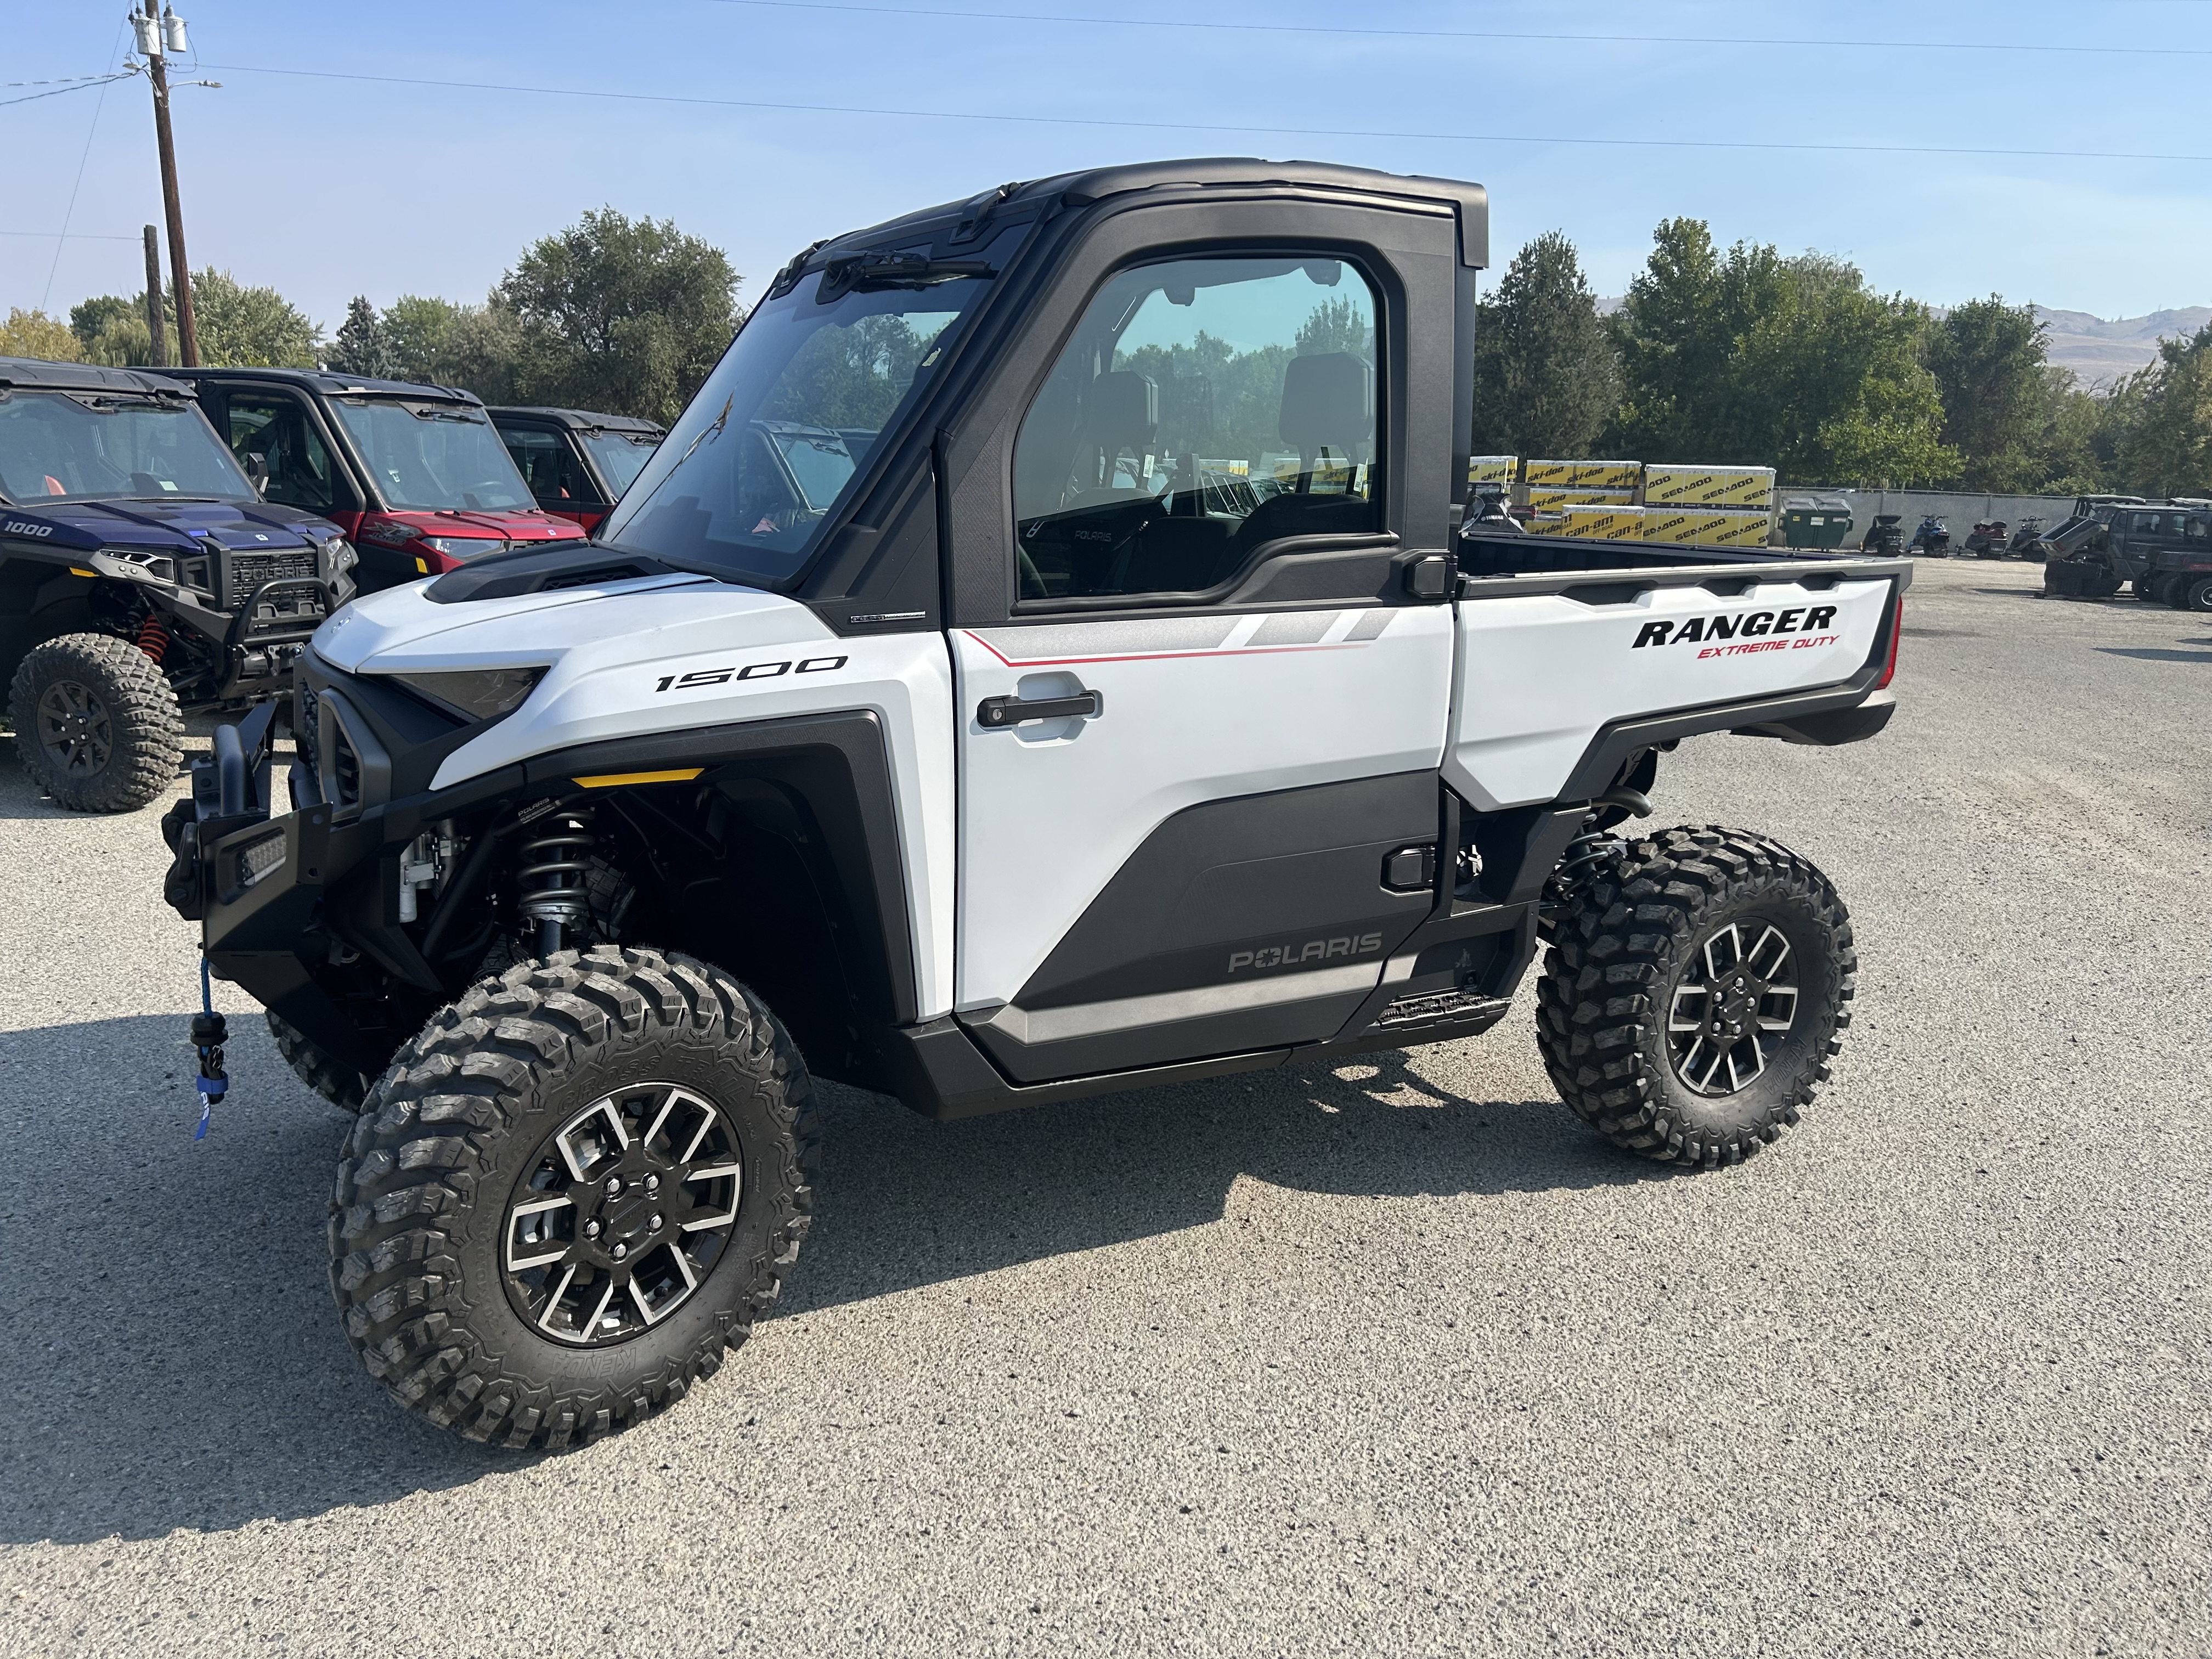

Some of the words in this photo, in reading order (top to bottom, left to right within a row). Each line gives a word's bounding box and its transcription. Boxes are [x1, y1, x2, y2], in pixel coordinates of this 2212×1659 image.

[4, 521, 53, 537] 1000
[1075, 531, 1111, 542] POLARIS
[241, 566, 310, 581] POLARIS
[1632, 605, 1837, 648] RANGER
[1697, 640, 1790, 659] EXTREME
[1792, 635, 1841, 649] DUTY
[655, 656, 848, 692] 1500
[518, 797, 550, 817] POLARIS
[1228, 932, 1382, 973] POLARIS
[550, 1347, 637, 1379] KENDA
